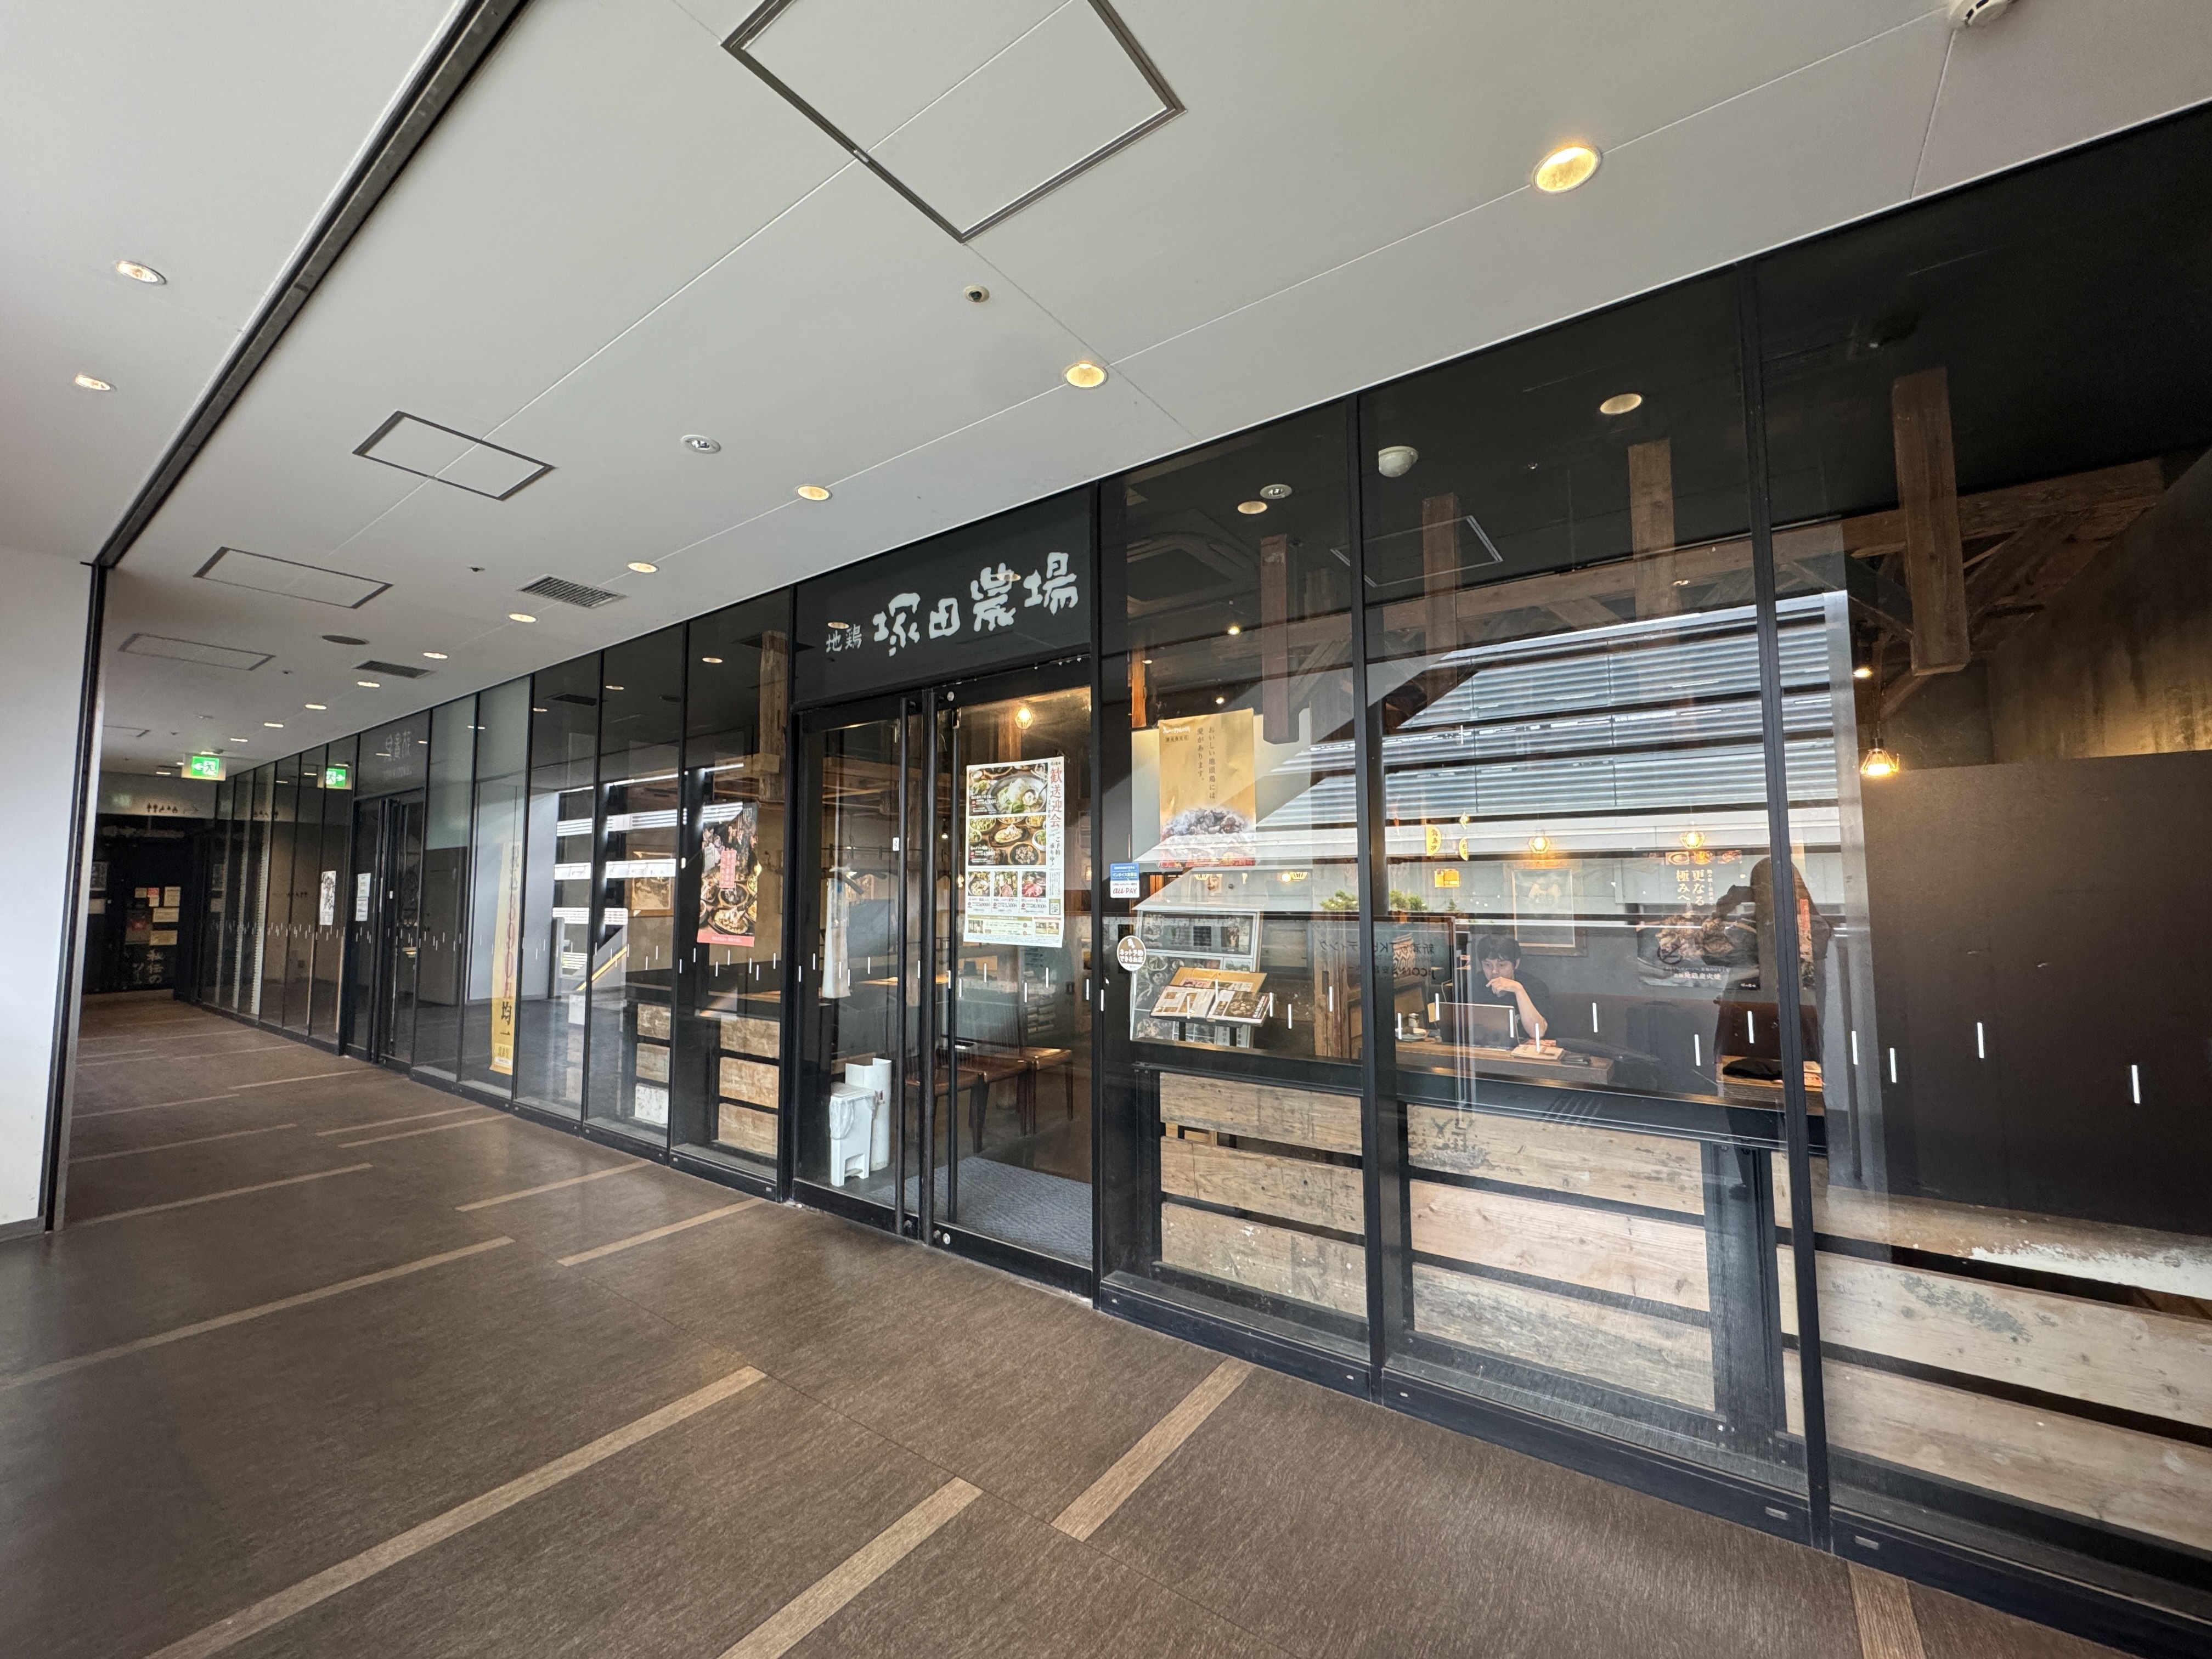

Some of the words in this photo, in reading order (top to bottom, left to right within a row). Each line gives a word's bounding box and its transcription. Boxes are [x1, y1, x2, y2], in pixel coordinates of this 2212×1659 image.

[873, 552, 1077, 657] 塚田農場
[826, 624, 862, 653] 地鶏
[1050, 767, 1063, 828] 歓送迎会
[1677, 870, 1691, 907] 極みへ。
[1692, 869, 1705, 906] 更なる
